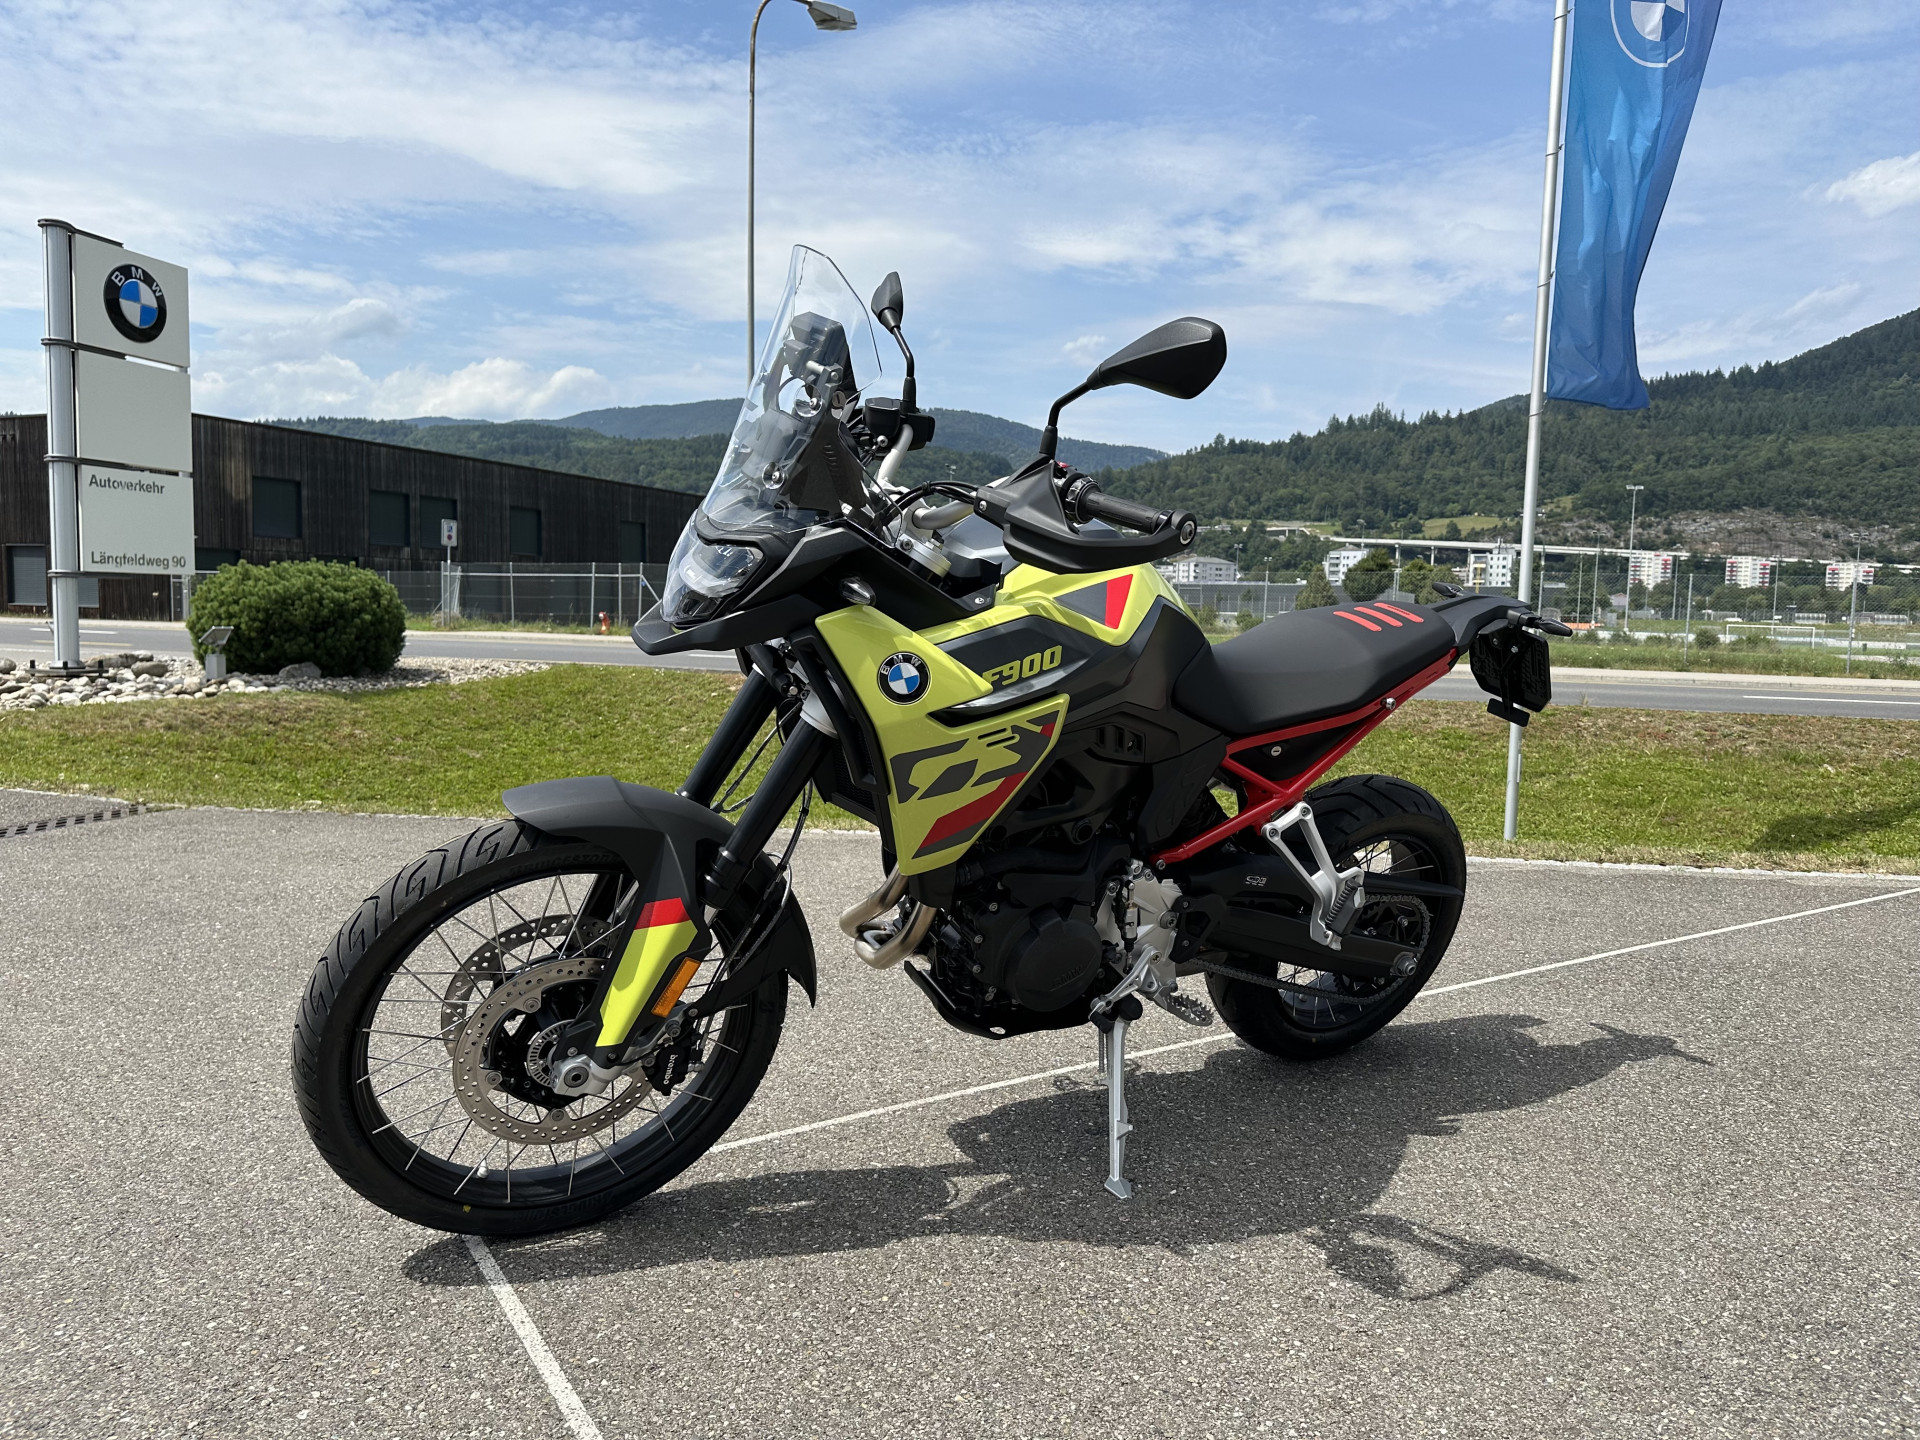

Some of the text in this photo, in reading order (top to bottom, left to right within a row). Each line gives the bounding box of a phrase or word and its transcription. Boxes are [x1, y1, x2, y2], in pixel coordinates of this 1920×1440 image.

[111, 266, 163, 298] BMW
[89, 474, 165, 494] Autoverkehr
[172, 555, 186, 568] 90
[881, 654, 922, 675] BMW
[982, 645, 1062, 686] F900
[663, 1054, 679, 1085] brembo
